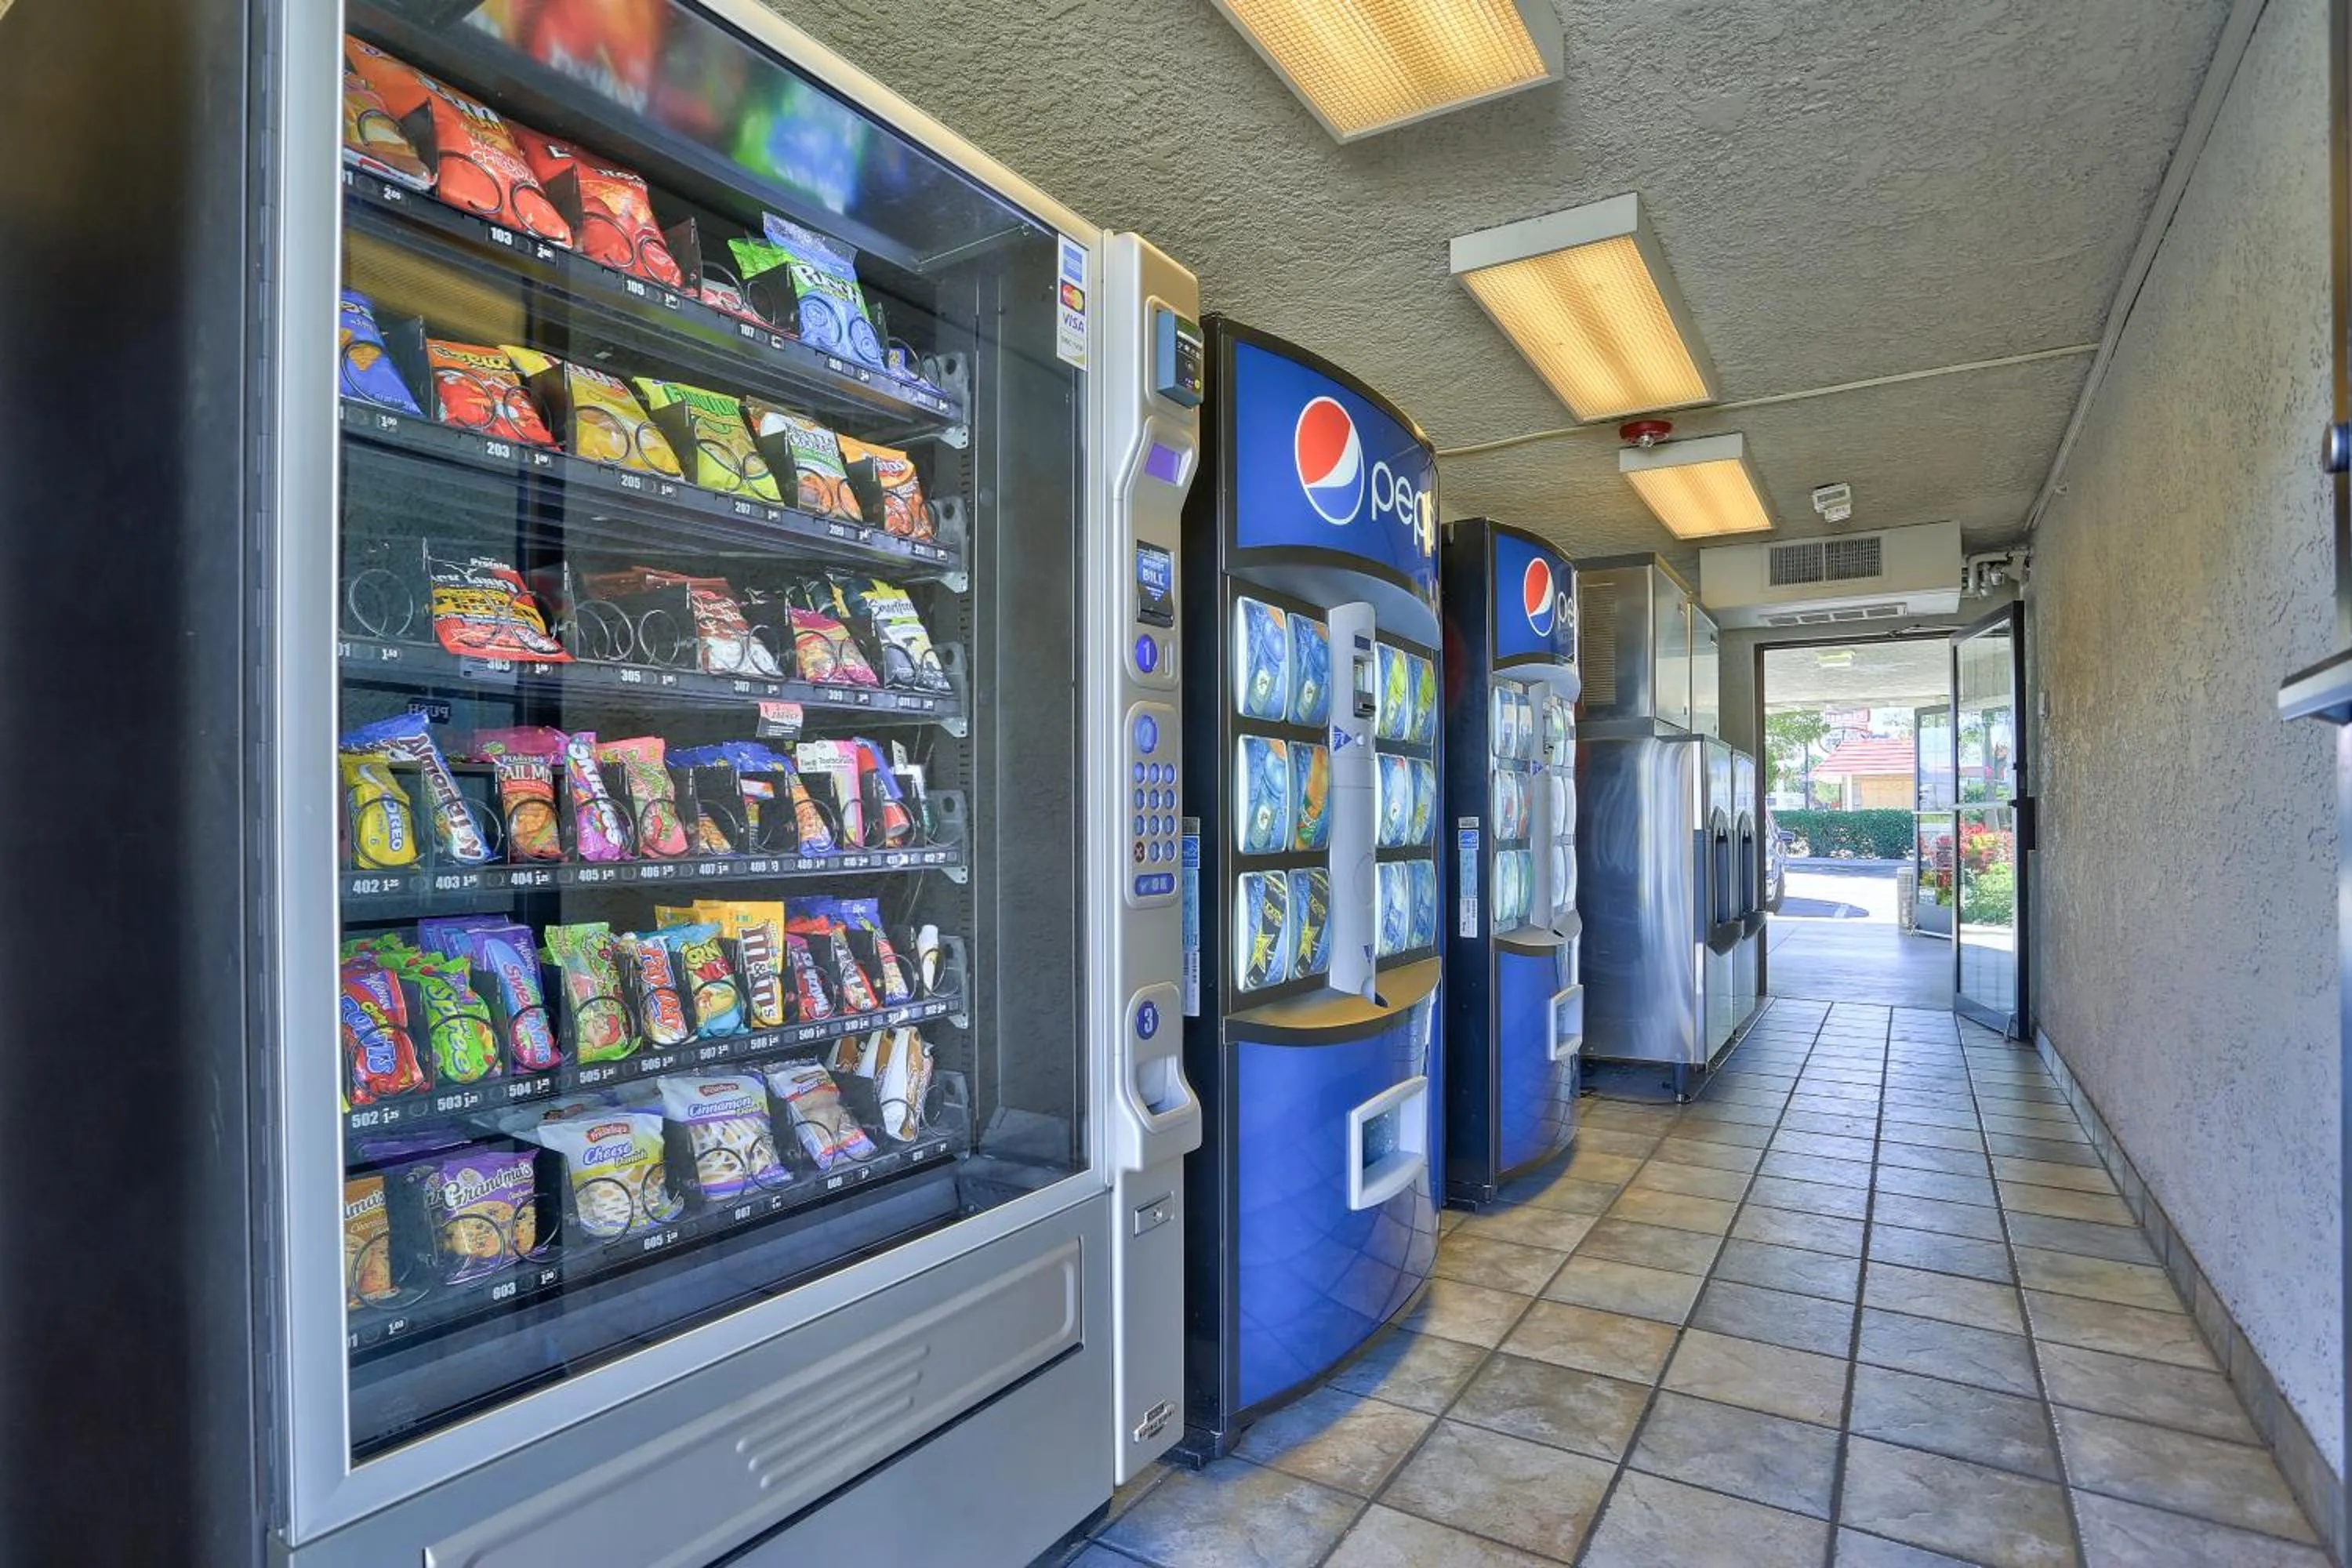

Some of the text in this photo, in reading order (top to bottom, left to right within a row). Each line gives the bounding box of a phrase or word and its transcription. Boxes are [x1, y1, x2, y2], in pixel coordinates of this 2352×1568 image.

[491, 227, 512, 245] 103
[627, 279, 645, 296] 105
[1062, 312, 1085, 333] VISA
[740, 324, 755, 339] 107
[487, 441, 510, 459] 203
[621, 474, 641, 490] 205
[735, 501, 751, 515] 207
[1142, 567, 1164, 586] BILL
[621, 670, 641, 683] 305
[734, 681, 750, 692] 307
[382, 793, 402, 851] OREO
[578, 869, 599, 882] 405
[641, 866, 659, 879] 406
[699, 862, 714, 875] 407
[352, 879, 379, 894] 402
[435, 876, 460, 890] 403
[510, 872, 533, 886] 404
[641, 1058, 662, 1072] 506
[579, 1069, 600, 1084] 505
[509, 1083, 532, 1098] 504
[437, 1095, 462, 1112] 503
[688, 1097, 753, 1118] Cinnamon
[352, 1110, 379, 1129] 502
[583, 1141, 633, 1166] Cheese
[441, 1160, 534, 1210] Grandma's
[644, 1235, 663, 1251] 605
[492, 1283, 517, 1301] 603
